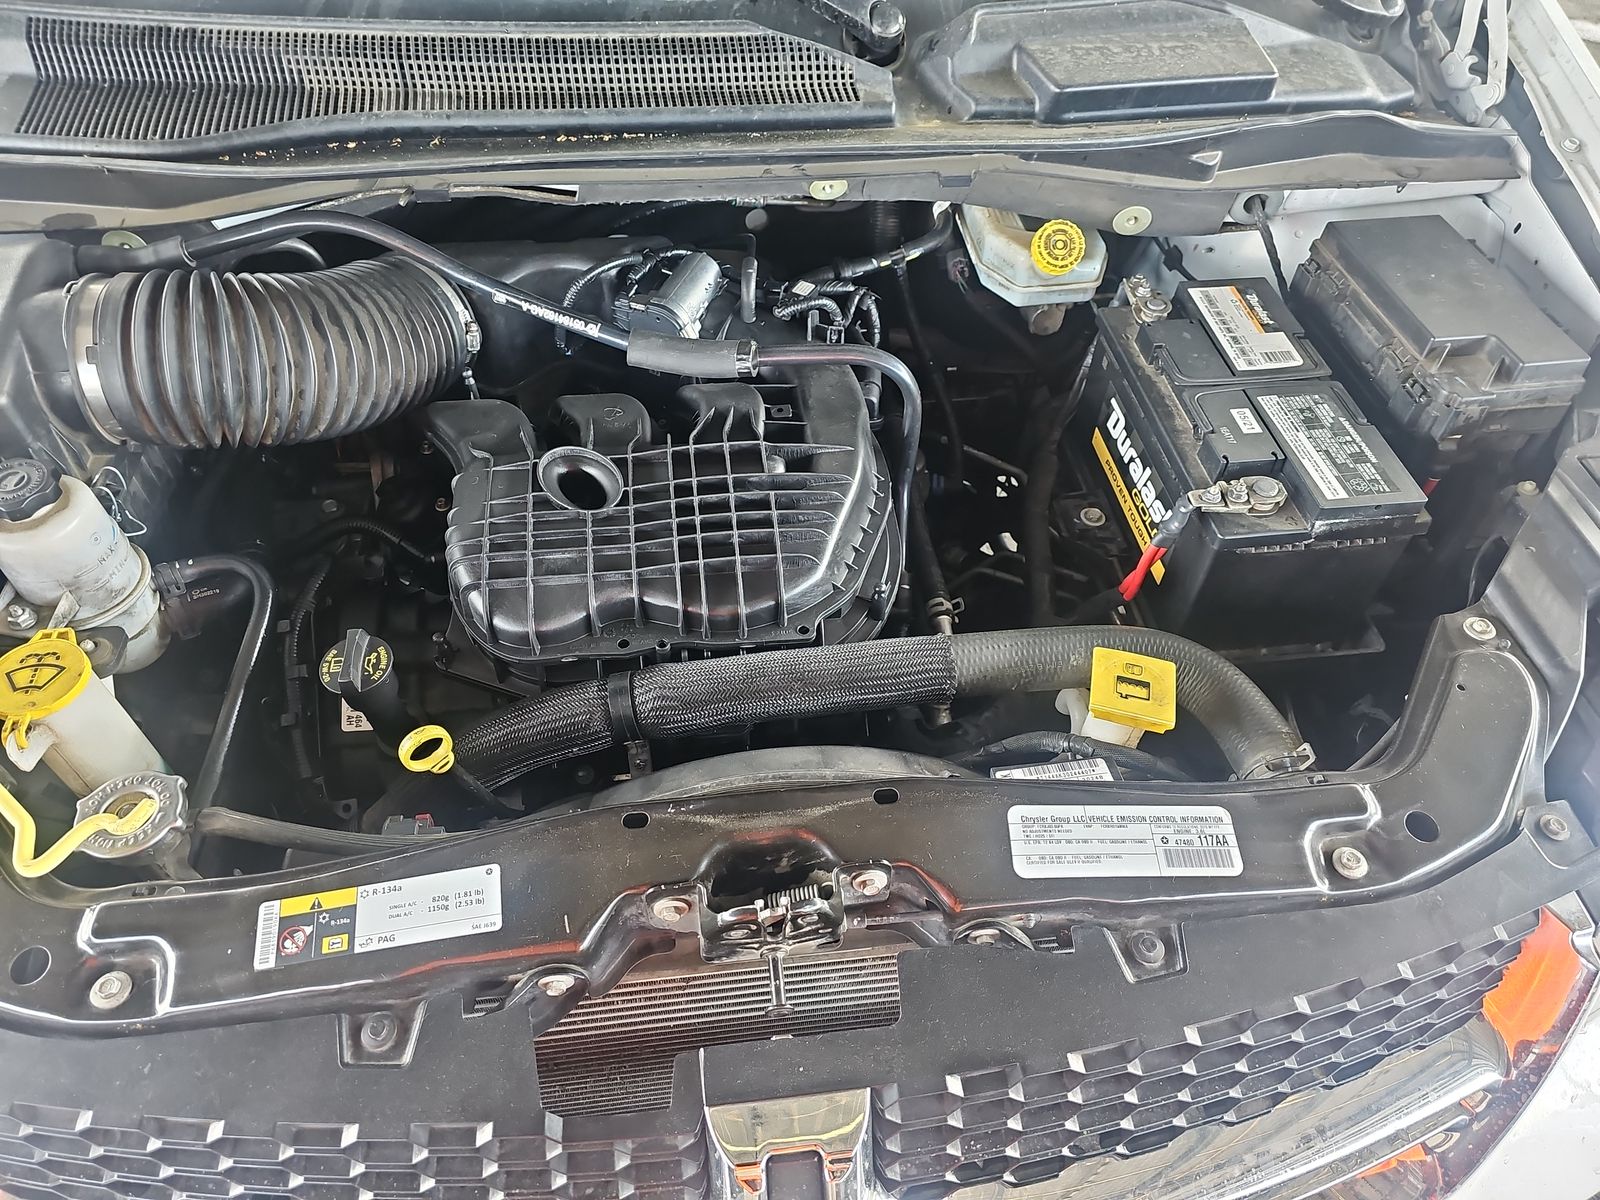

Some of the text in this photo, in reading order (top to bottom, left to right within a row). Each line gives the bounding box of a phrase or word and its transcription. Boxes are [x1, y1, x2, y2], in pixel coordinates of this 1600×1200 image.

[1245, 293, 1275, 325] Duralast
[1237, 410, 1255, 430] 05/21
[1105, 459, 1148, 546] PROVEN TOUGH
[370, 646, 388, 681] ENGINE OIL
[322, 662, 331, 683] 5W-20
[346, 715, 354, 726] AH
[354, 714, 363, 728] 464
[1020, 815, 1085, 825] Chrysler Group LLC
[1087, 815, 1114, 823] VEHICLE
[1116, 815, 1147, 823] EMISSION
[1149, 815, 1178, 823] CONTROL
[1197, 834, 1229, 846] 117AA
[372, 885, 402, 896] R-134a
[388, 903, 406, 911] SINGLE
[431, 894, 450, 903] 820g
[454, 890, 472, 900] (1.81
[474, 888, 484, 897] lb)
[427, 904, 450, 913] 1150g
[455, 899, 473, 909] (2.53
[475, 897, 485, 906] lb)
[483, 921, 497, 929] J639
[377, 934, 396, 944] PAG
